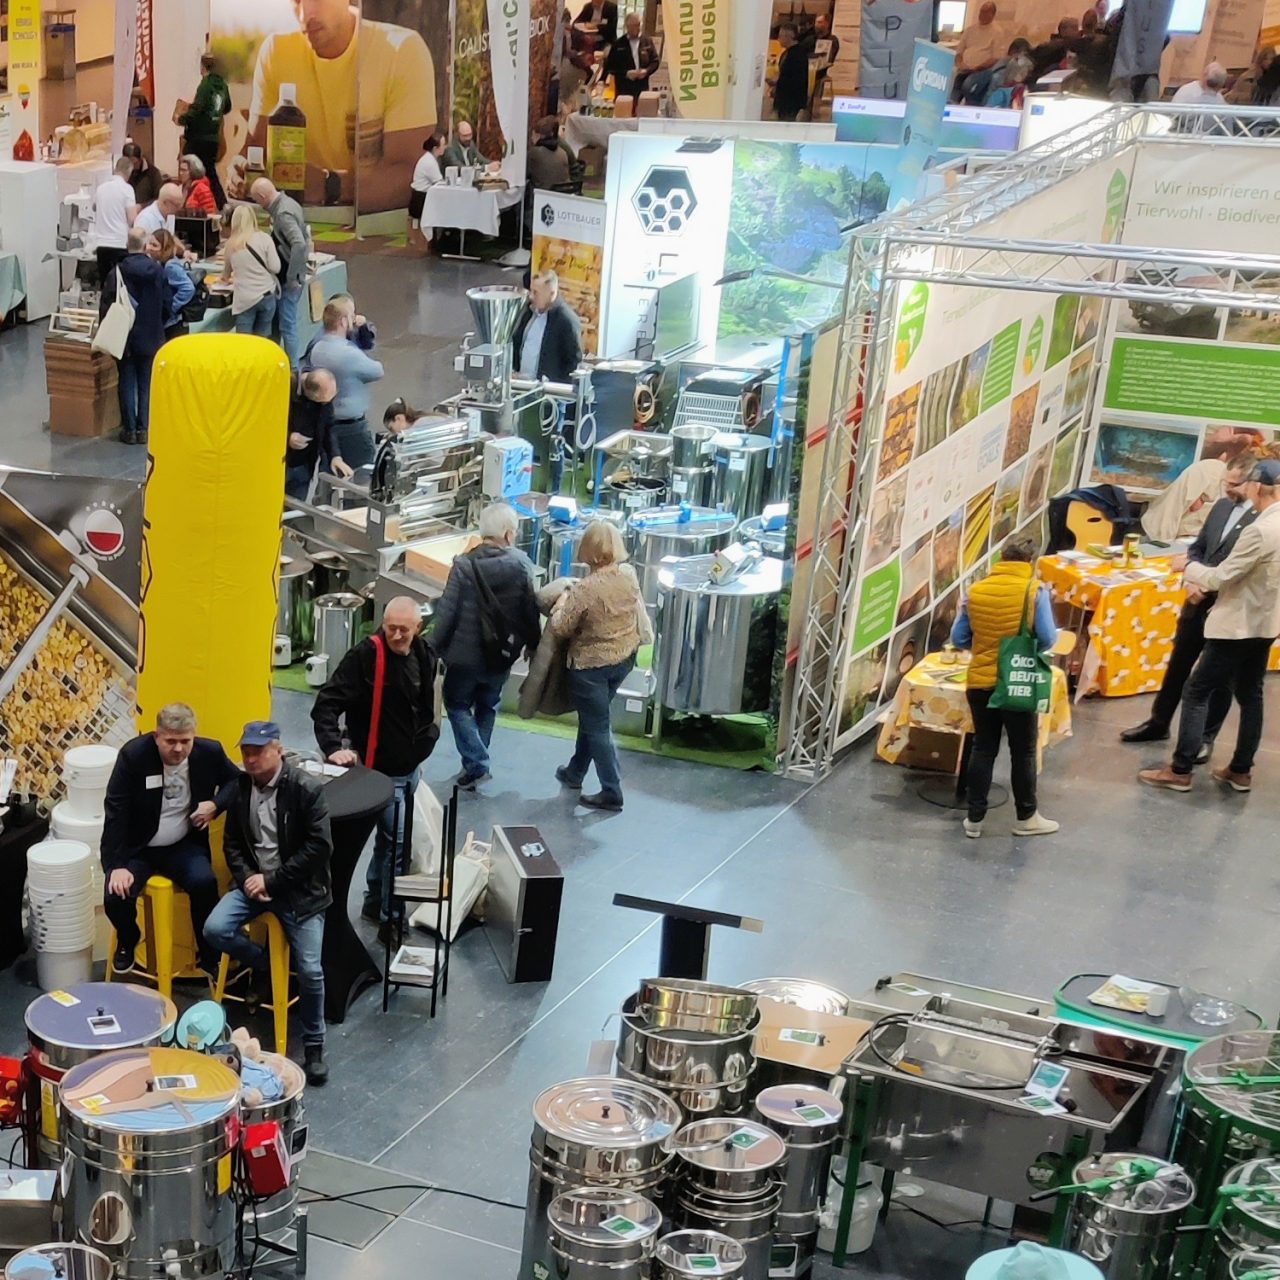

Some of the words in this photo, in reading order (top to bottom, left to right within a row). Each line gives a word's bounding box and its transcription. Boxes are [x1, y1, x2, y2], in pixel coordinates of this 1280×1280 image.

[458, 32, 490, 58] CALIS
[1154, 179, 1182, 195] Wir
[1187, 182, 1269, 200] inspirieren
[556, 210, 601, 226] LOTTBAUER
[1136, 202, 1203, 220] Tierwohl
[1010, 653, 1035, 668] ÖKO
[1006, 685, 1032, 697] TIER
